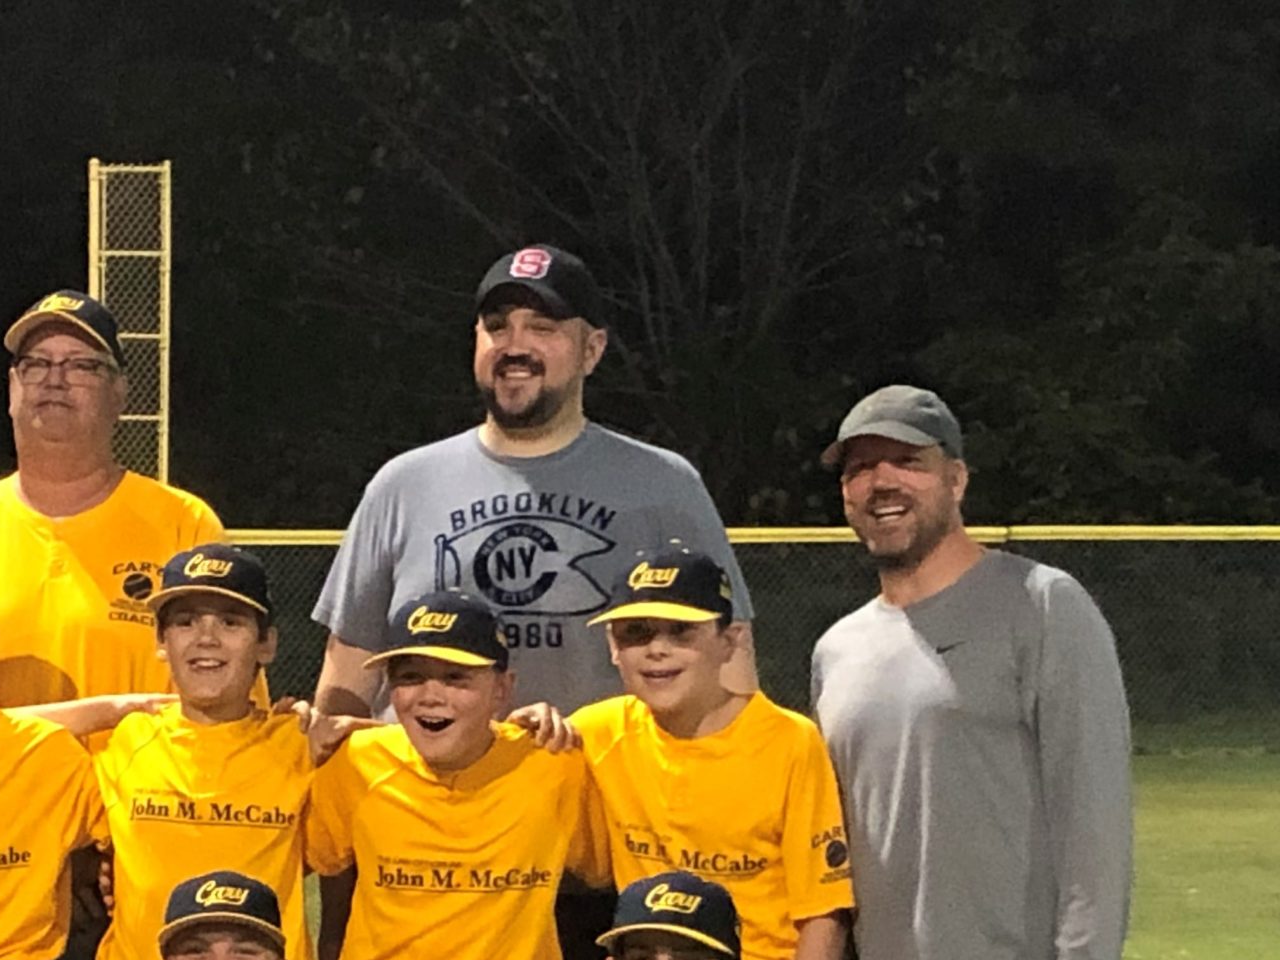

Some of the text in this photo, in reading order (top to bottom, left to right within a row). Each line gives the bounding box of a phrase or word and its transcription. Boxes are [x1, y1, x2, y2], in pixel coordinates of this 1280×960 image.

[509, 248, 552, 279] S
[450, 492, 616, 531] BROOKLYN
[184, 553, 233, 578] Cary
[496, 545, 536, 581] NY
[627, 562, 679, 590] Cary
[407, 605, 458, 634] Cary
[507, 623, 562, 648] 980
[130, 798, 295, 826] John M. McCabe
[811, 826, 842, 849] CAR
[679, 849, 769, 872] McCabe
[375, 865, 551, 888] John M. McCabe
[195, 880, 249, 907] Cary
[644, 883, 702, 914] Cary
